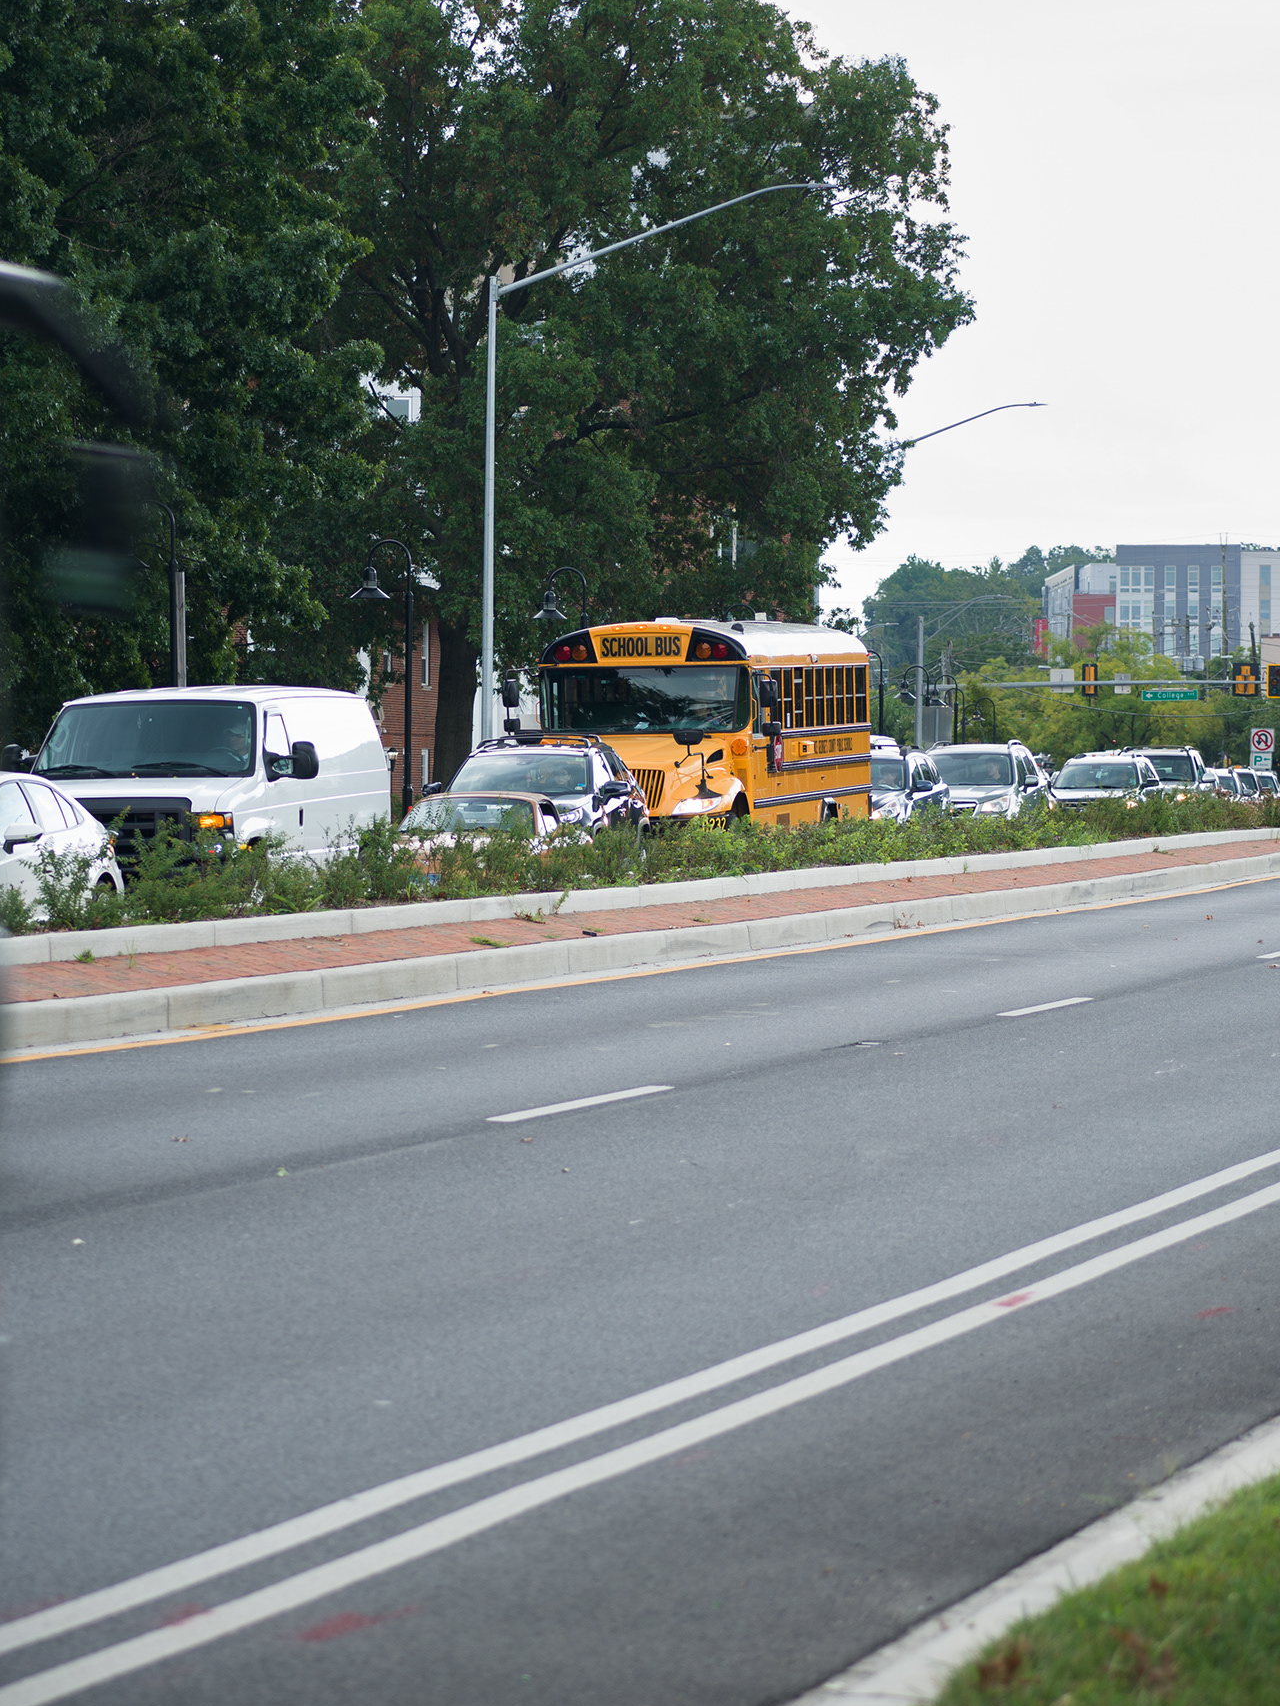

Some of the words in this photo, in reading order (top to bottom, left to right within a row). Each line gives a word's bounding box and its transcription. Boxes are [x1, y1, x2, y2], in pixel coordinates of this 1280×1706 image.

[602, 637, 652, 657] SCHOOL
[655, 636, 680, 656] BUS
[1254, 756, 1263, 766] P
